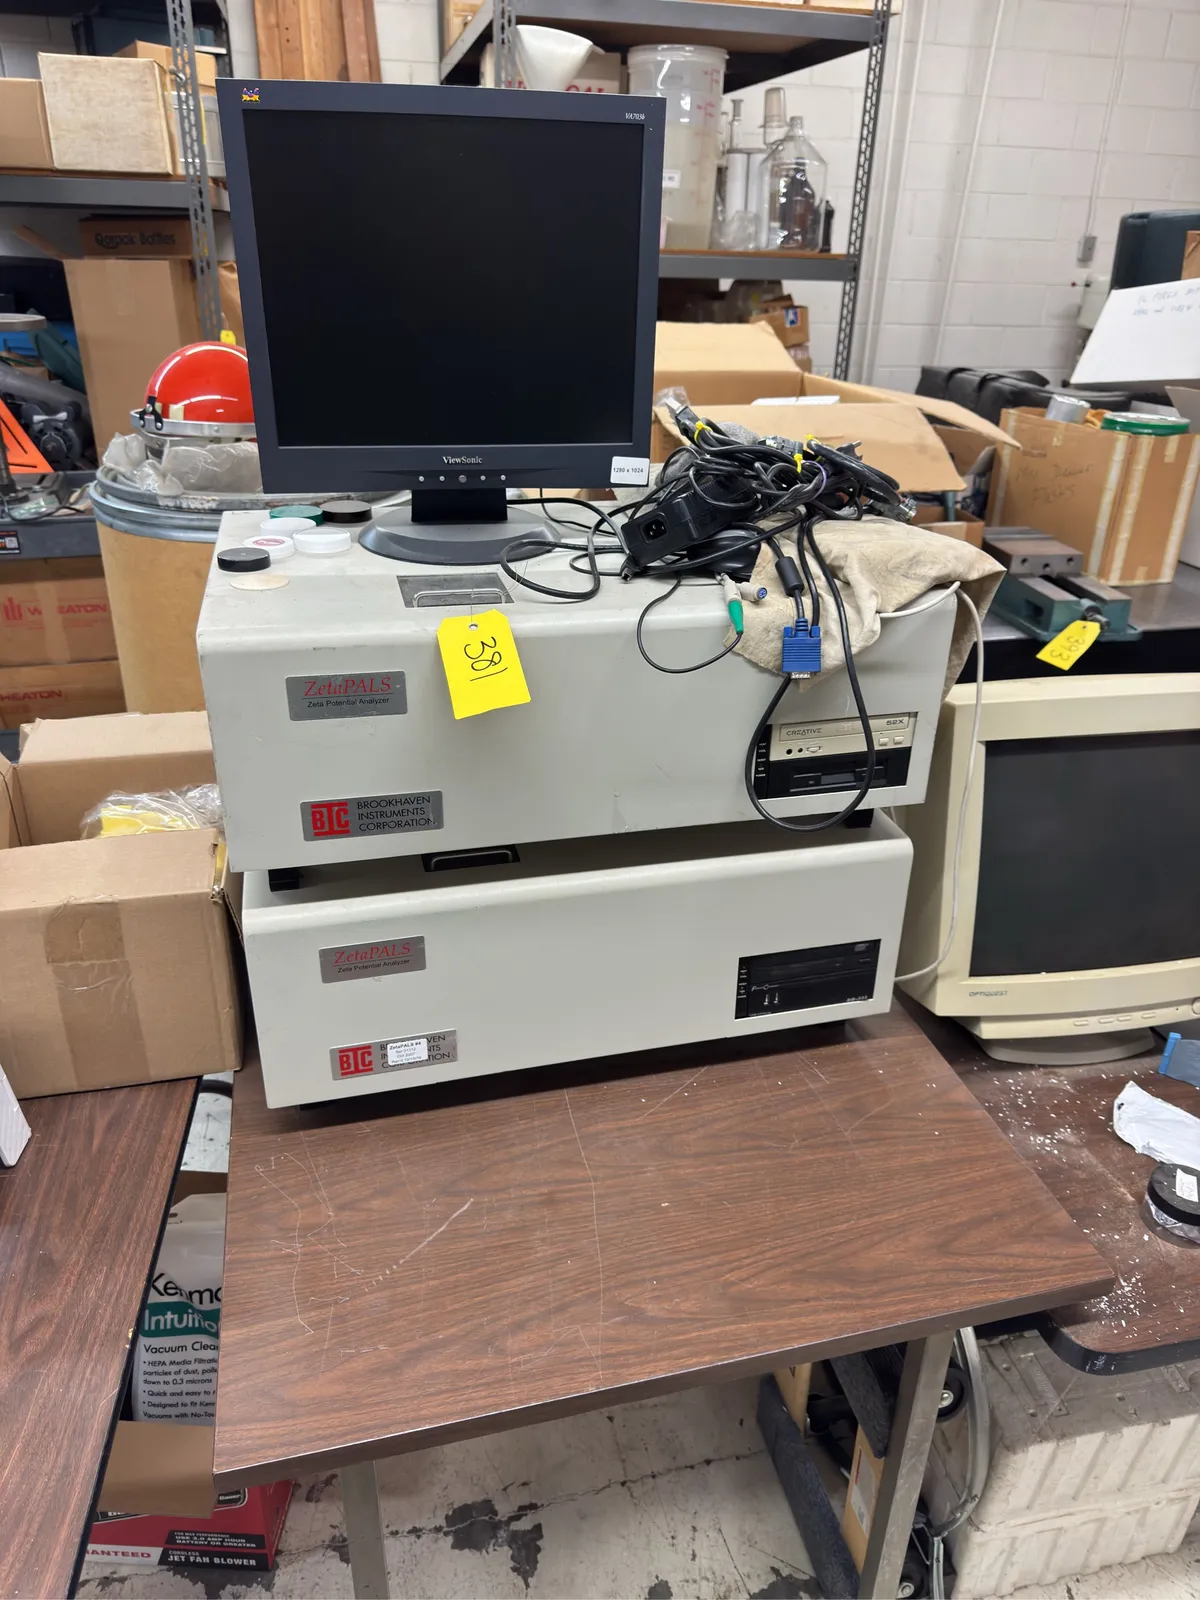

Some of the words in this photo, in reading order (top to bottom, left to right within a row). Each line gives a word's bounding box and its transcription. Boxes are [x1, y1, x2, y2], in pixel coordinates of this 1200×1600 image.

[442, 455, 483, 465] ViewSonic
[26, 603, 108, 616] WEATON
[463, 635, 509, 682] 381
[304, 676, 392, 697] ZetaPALS
[307, 701, 325, 709] Zeta
[326, 698, 357, 707] Potential
[359, 696, 390, 706] Analyzer
[786, 727, 822, 737] CREATIVE
[885, 718, 904, 726] 52X
[357, 795, 432, 810] BROOKHAVEN
[358, 806, 426, 821] INSTRUMENTS
[358, 817, 436, 832] CORPORATION
[333, 941, 412, 965] ZetaPALS
[337, 965, 353, 973] Zeta
[354, 961, 382, 971] Potential
[382, 958, 410, 968] Analyzer
[389, 1042, 414, 1051] ZetaPALS
[143, 1344, 188, 1354] Vacuum
[185, 1390, 202, 1398] easy
[147, 1401, 179, 1409] Designed
[143, 1411, 172, 1419] Vacuums
[213, 1557, 257, 1566] BLOWER
